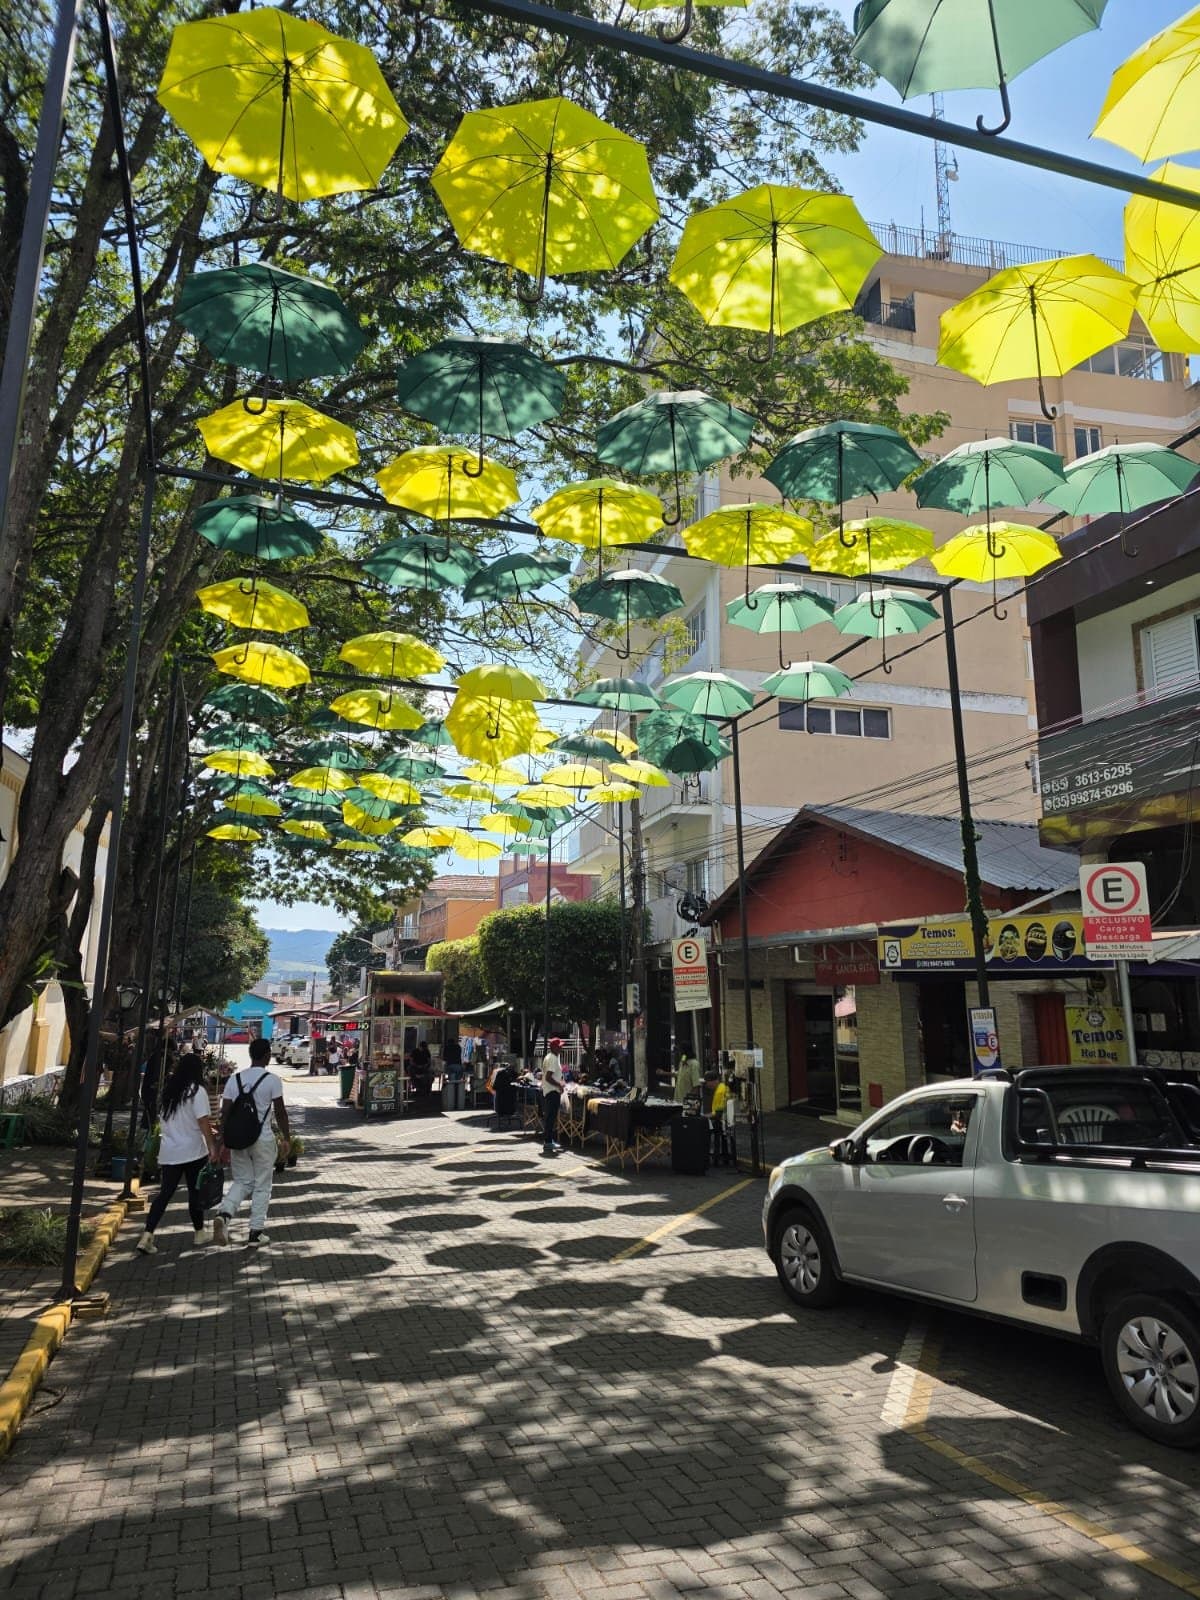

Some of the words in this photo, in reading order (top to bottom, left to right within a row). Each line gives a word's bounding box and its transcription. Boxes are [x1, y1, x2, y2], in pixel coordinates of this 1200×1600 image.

[1075, 763, 1133, 787] 3613-6295
[1102, 878, 1124, 903] E
[1088, 916, 1145, 925] EXCLUSIVO
[920, 928, 956, 938] Temos:
[1099, 925, 1128, 933] Carga
[1095, 934, 1140, 942] Descarga
[684, 945, 693, 959] E
[1071, 1029, 1124, 1044] Temos
[1080, 1048, 1097, 1058] Hot
